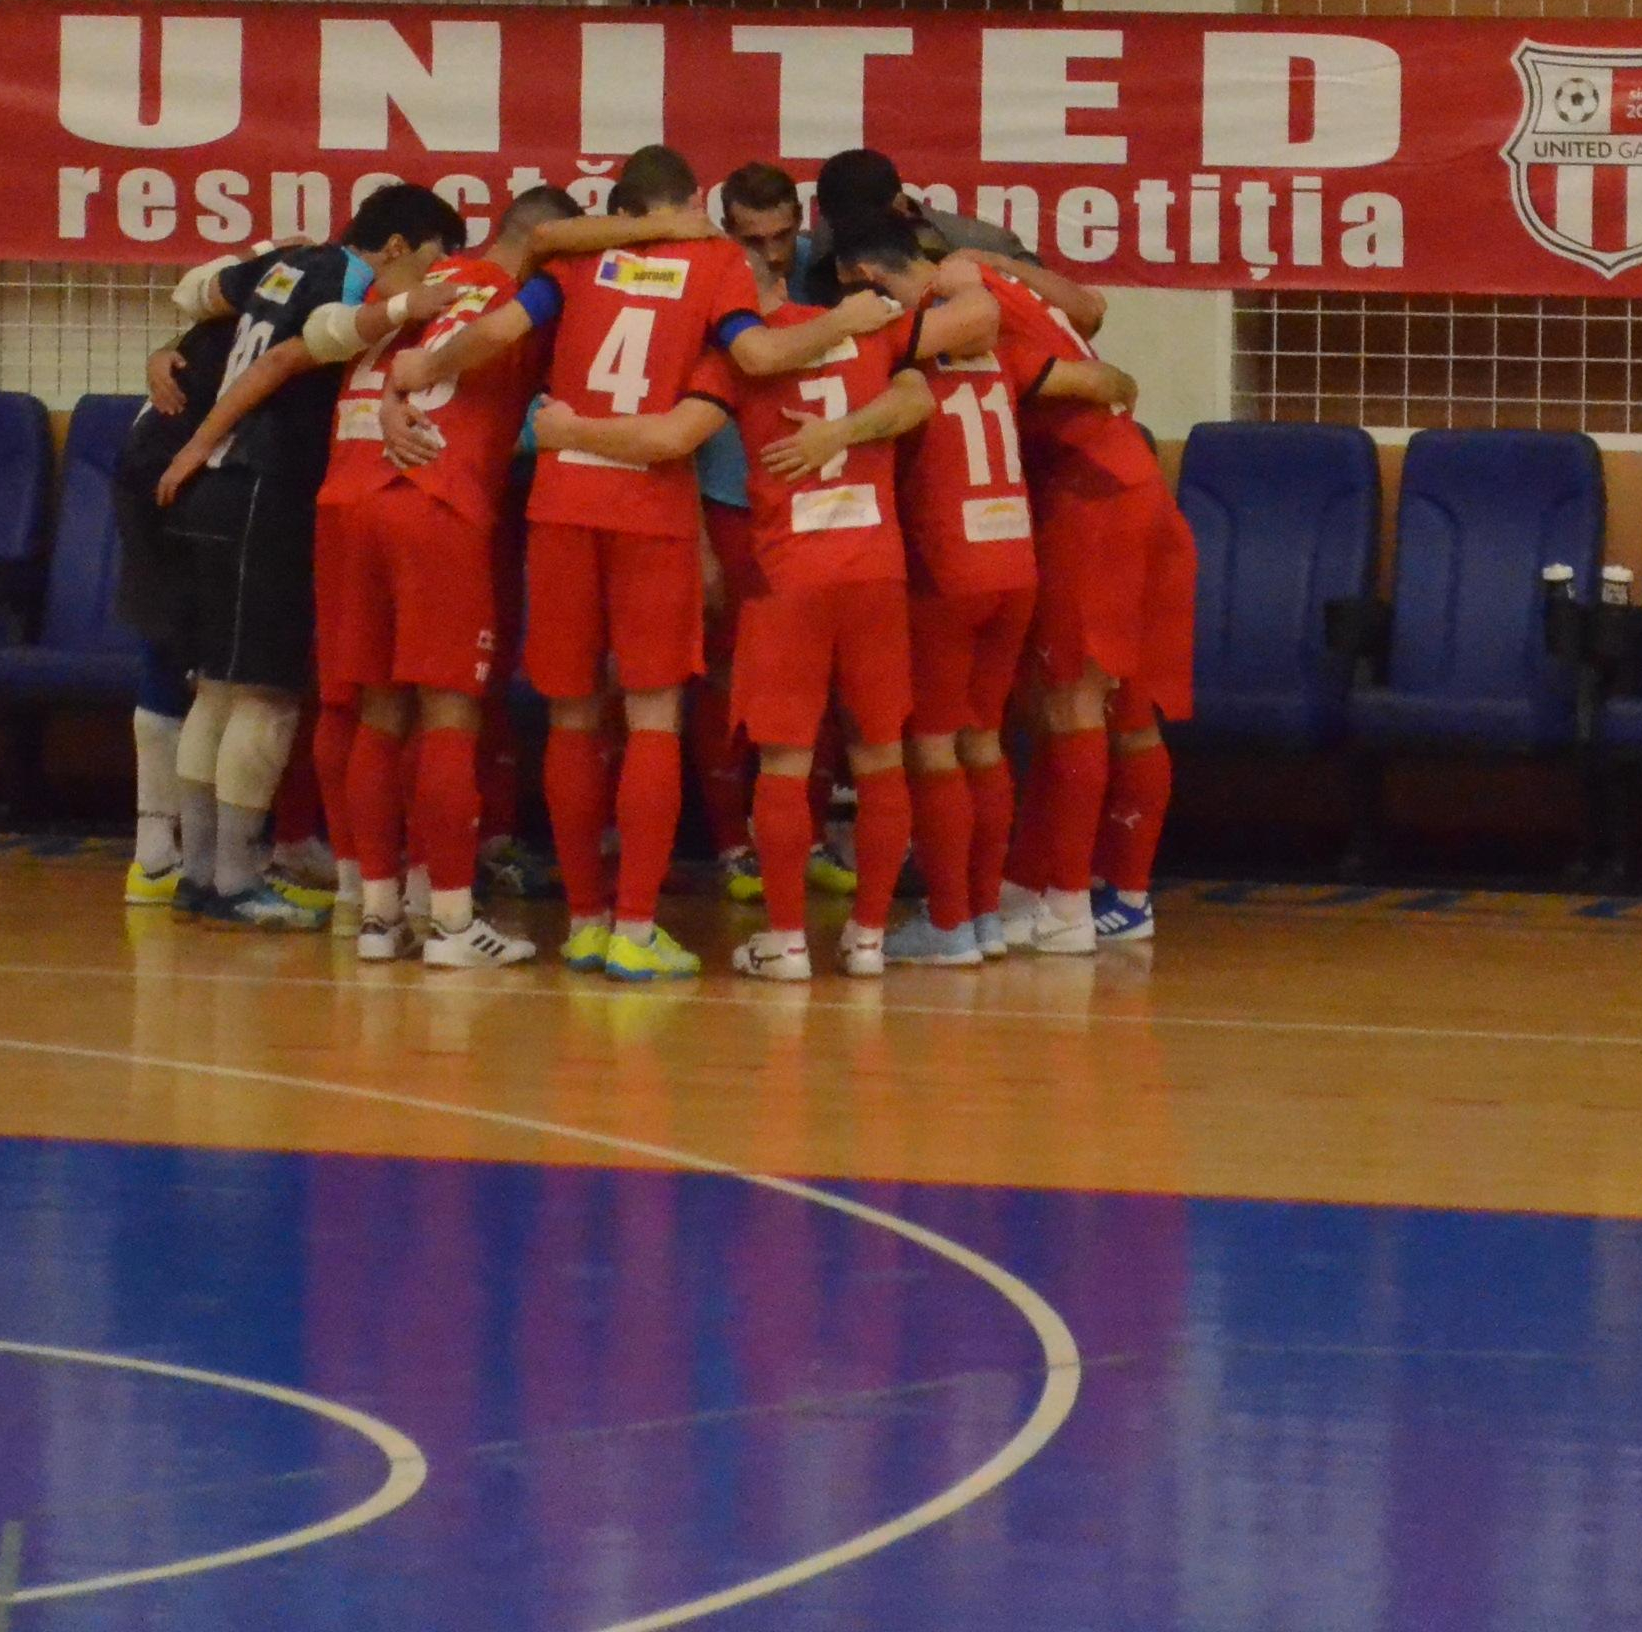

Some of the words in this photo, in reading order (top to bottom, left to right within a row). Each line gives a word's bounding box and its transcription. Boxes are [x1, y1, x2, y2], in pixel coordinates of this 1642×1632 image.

[58, 15, 1403, 169] UNITED
[1534, 142, 1612, 158] UNITED
[587, 307, 656, 414] 4
[943, 381, 1022, 486] 11
